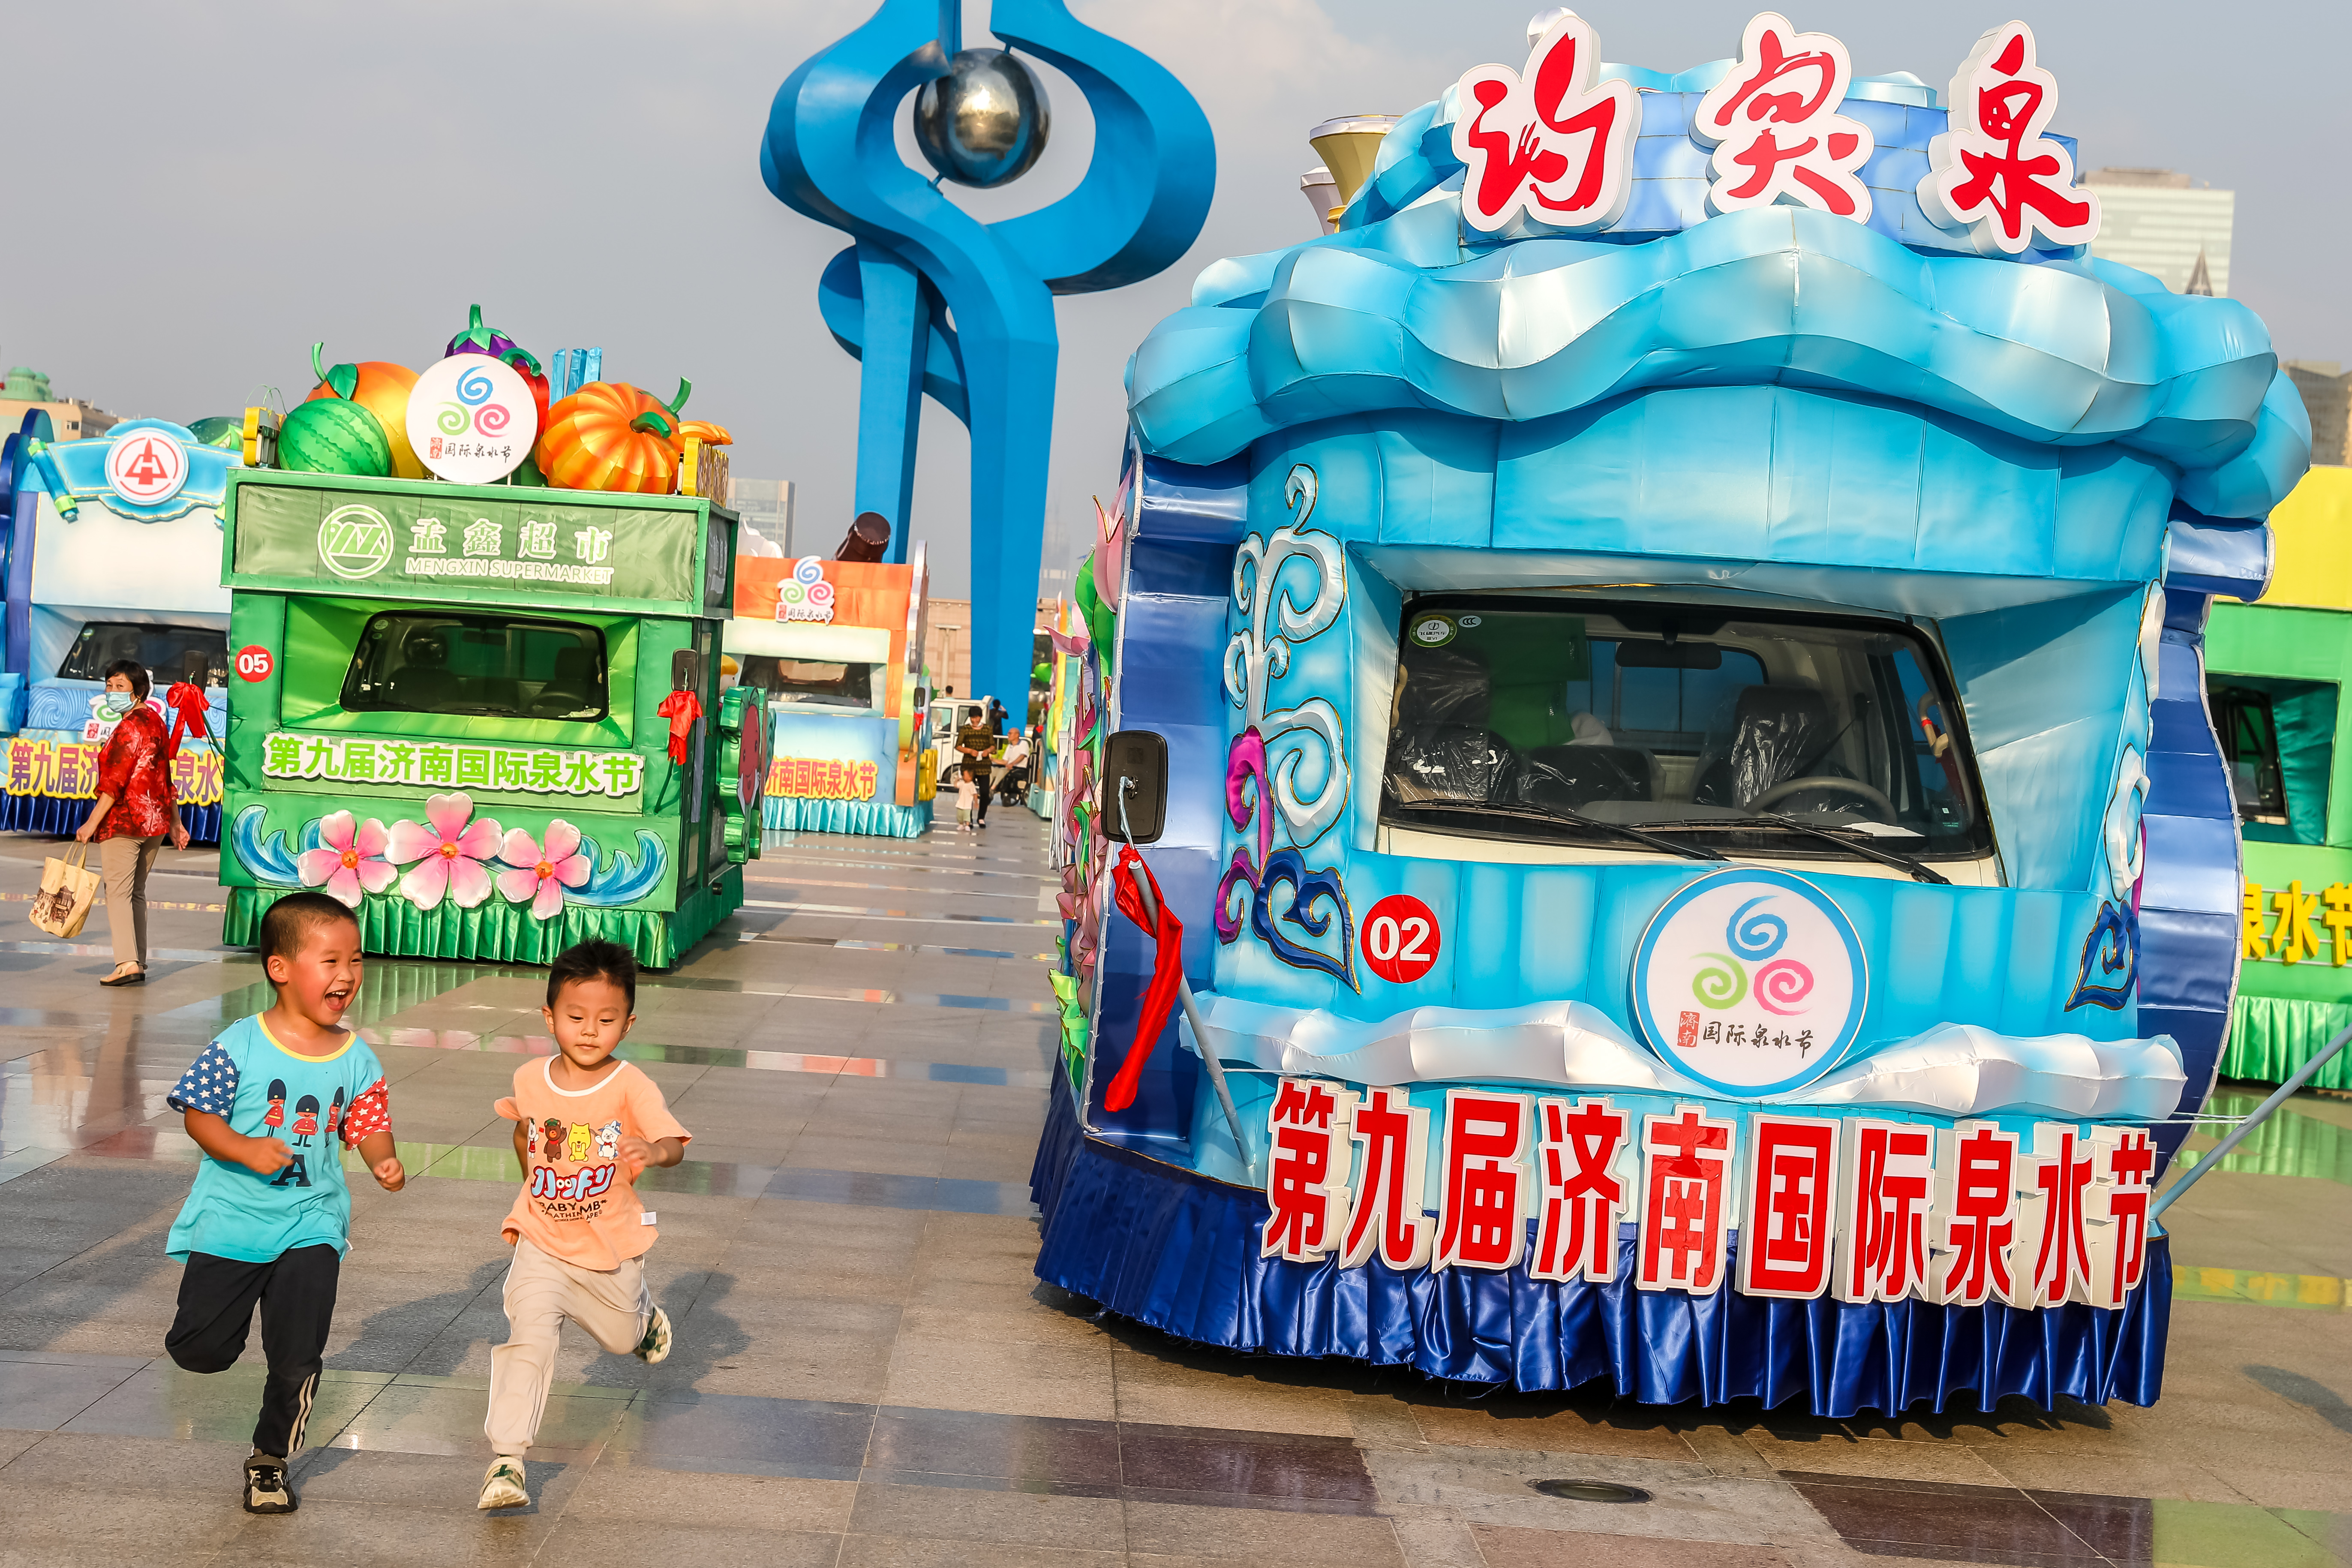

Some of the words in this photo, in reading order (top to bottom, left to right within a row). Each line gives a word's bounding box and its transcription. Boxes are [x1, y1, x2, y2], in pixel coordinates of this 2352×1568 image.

[412, 520, 611, 562] 孟鑫超市
[408, 559, 487, 575] MENGXIN
[491, 561, 613, 582] SUPERMARKET
[239, 654, 269, 674] 05
[10, 742, 224, 803] 第九届济泉水
[268, 736, 640, 793] 第九届济南国际泉水节
[1370, 916, 1430, 961] 02
[1703, 1021, 1814, 1059] 国际泉水节
[270, 1154, 312, 1187] A
[1265, 1079, 2155, 1305] 第九届济南国际泉水节
